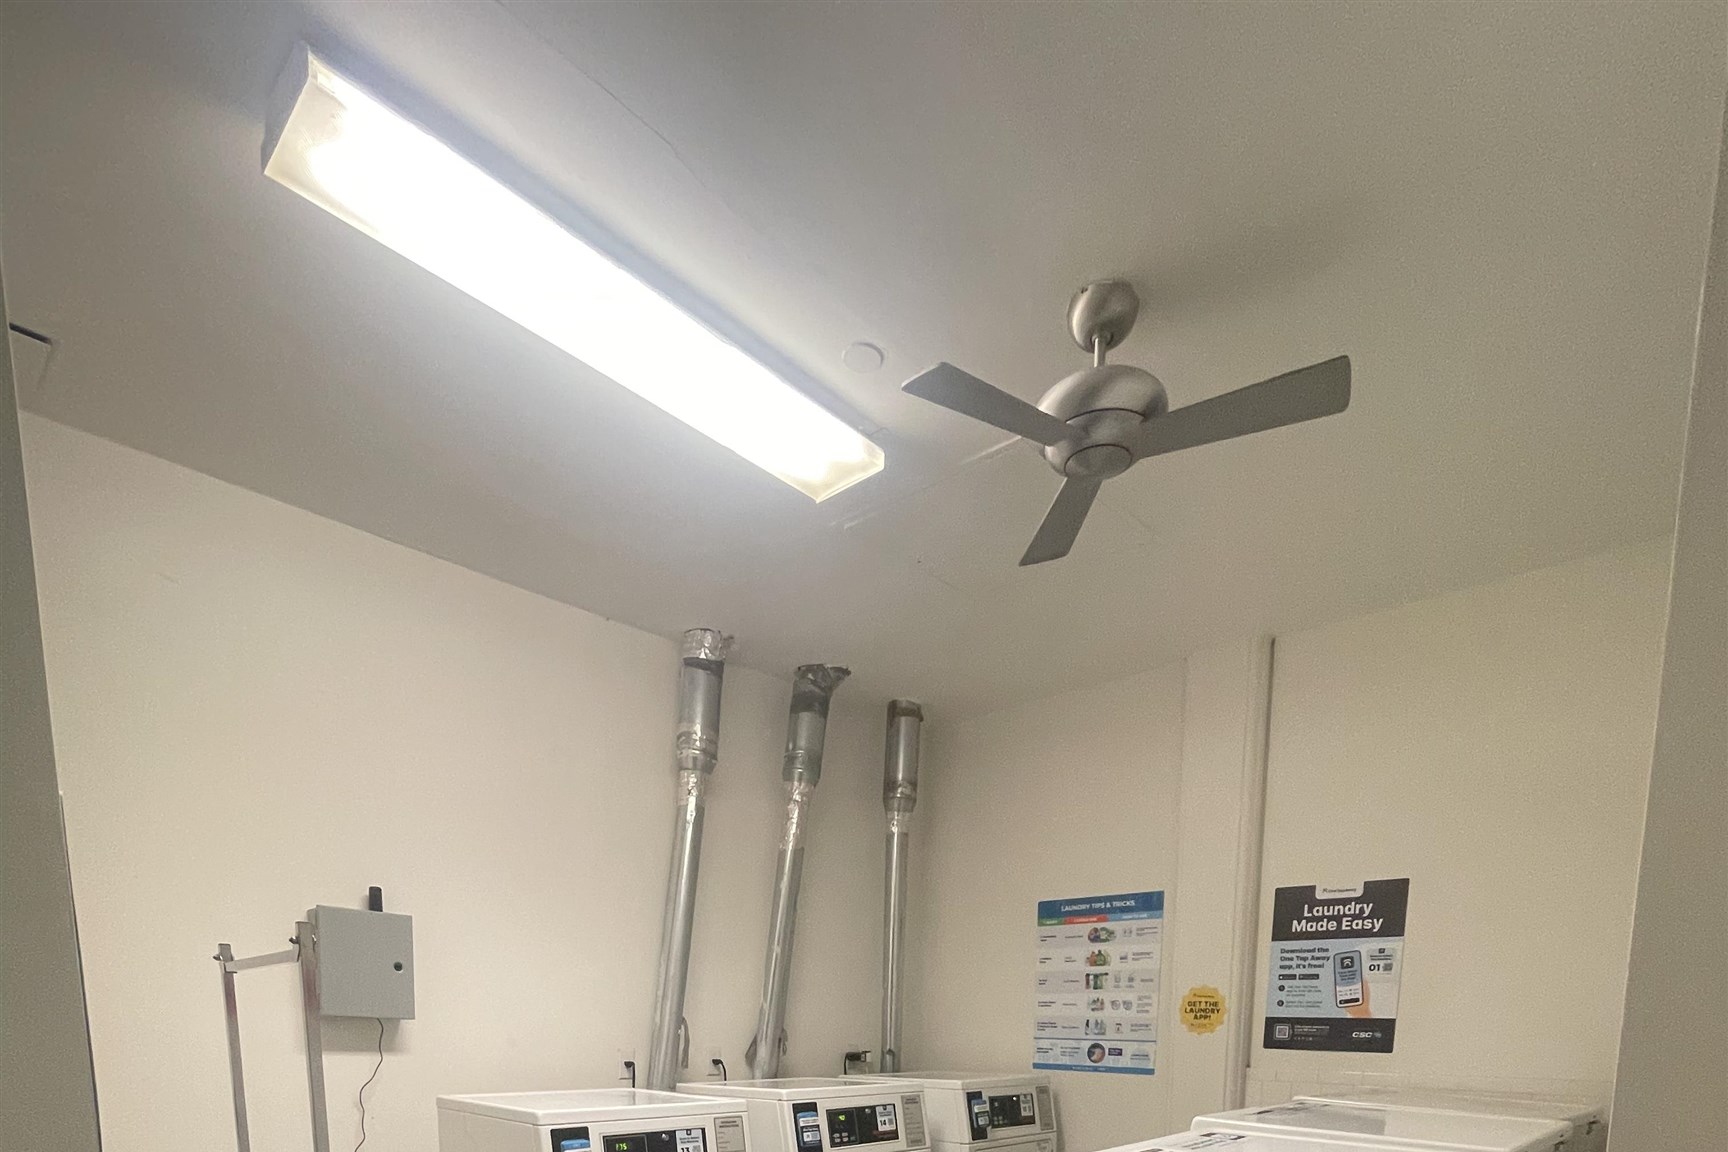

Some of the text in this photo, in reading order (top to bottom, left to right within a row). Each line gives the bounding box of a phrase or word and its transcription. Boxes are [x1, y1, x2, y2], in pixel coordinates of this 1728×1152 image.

[1061, 904, 1090, 912] LAUNDRY
[1112, 900, 1136, 908] TRICKS
[1303, 901, 1373, 917] Laundry
[1291, 917, 1383, 933] Made Easy
[1368, 963, 1380, 971] 01
